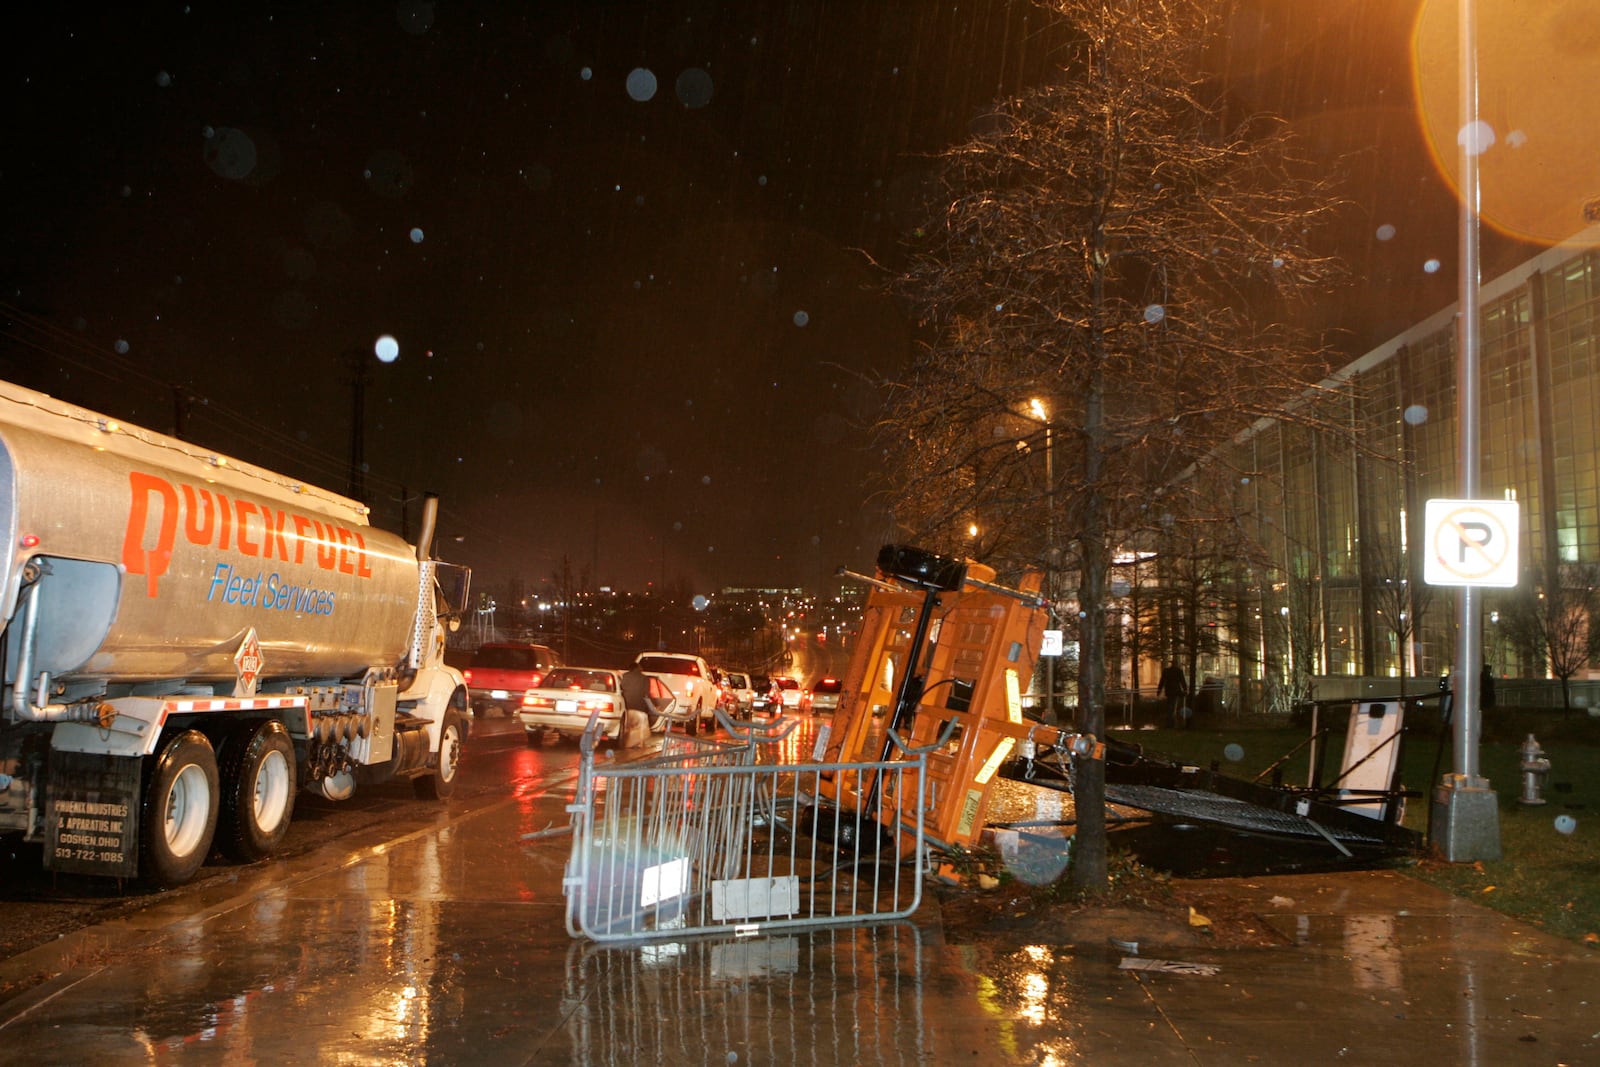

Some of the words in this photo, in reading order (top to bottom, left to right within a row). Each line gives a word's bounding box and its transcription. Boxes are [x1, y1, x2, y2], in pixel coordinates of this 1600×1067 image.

[208, 564, 263, 606] Fleet
[263, 573, 336, 616] Services
[55, 848, 123, 862] 513-722-1085
